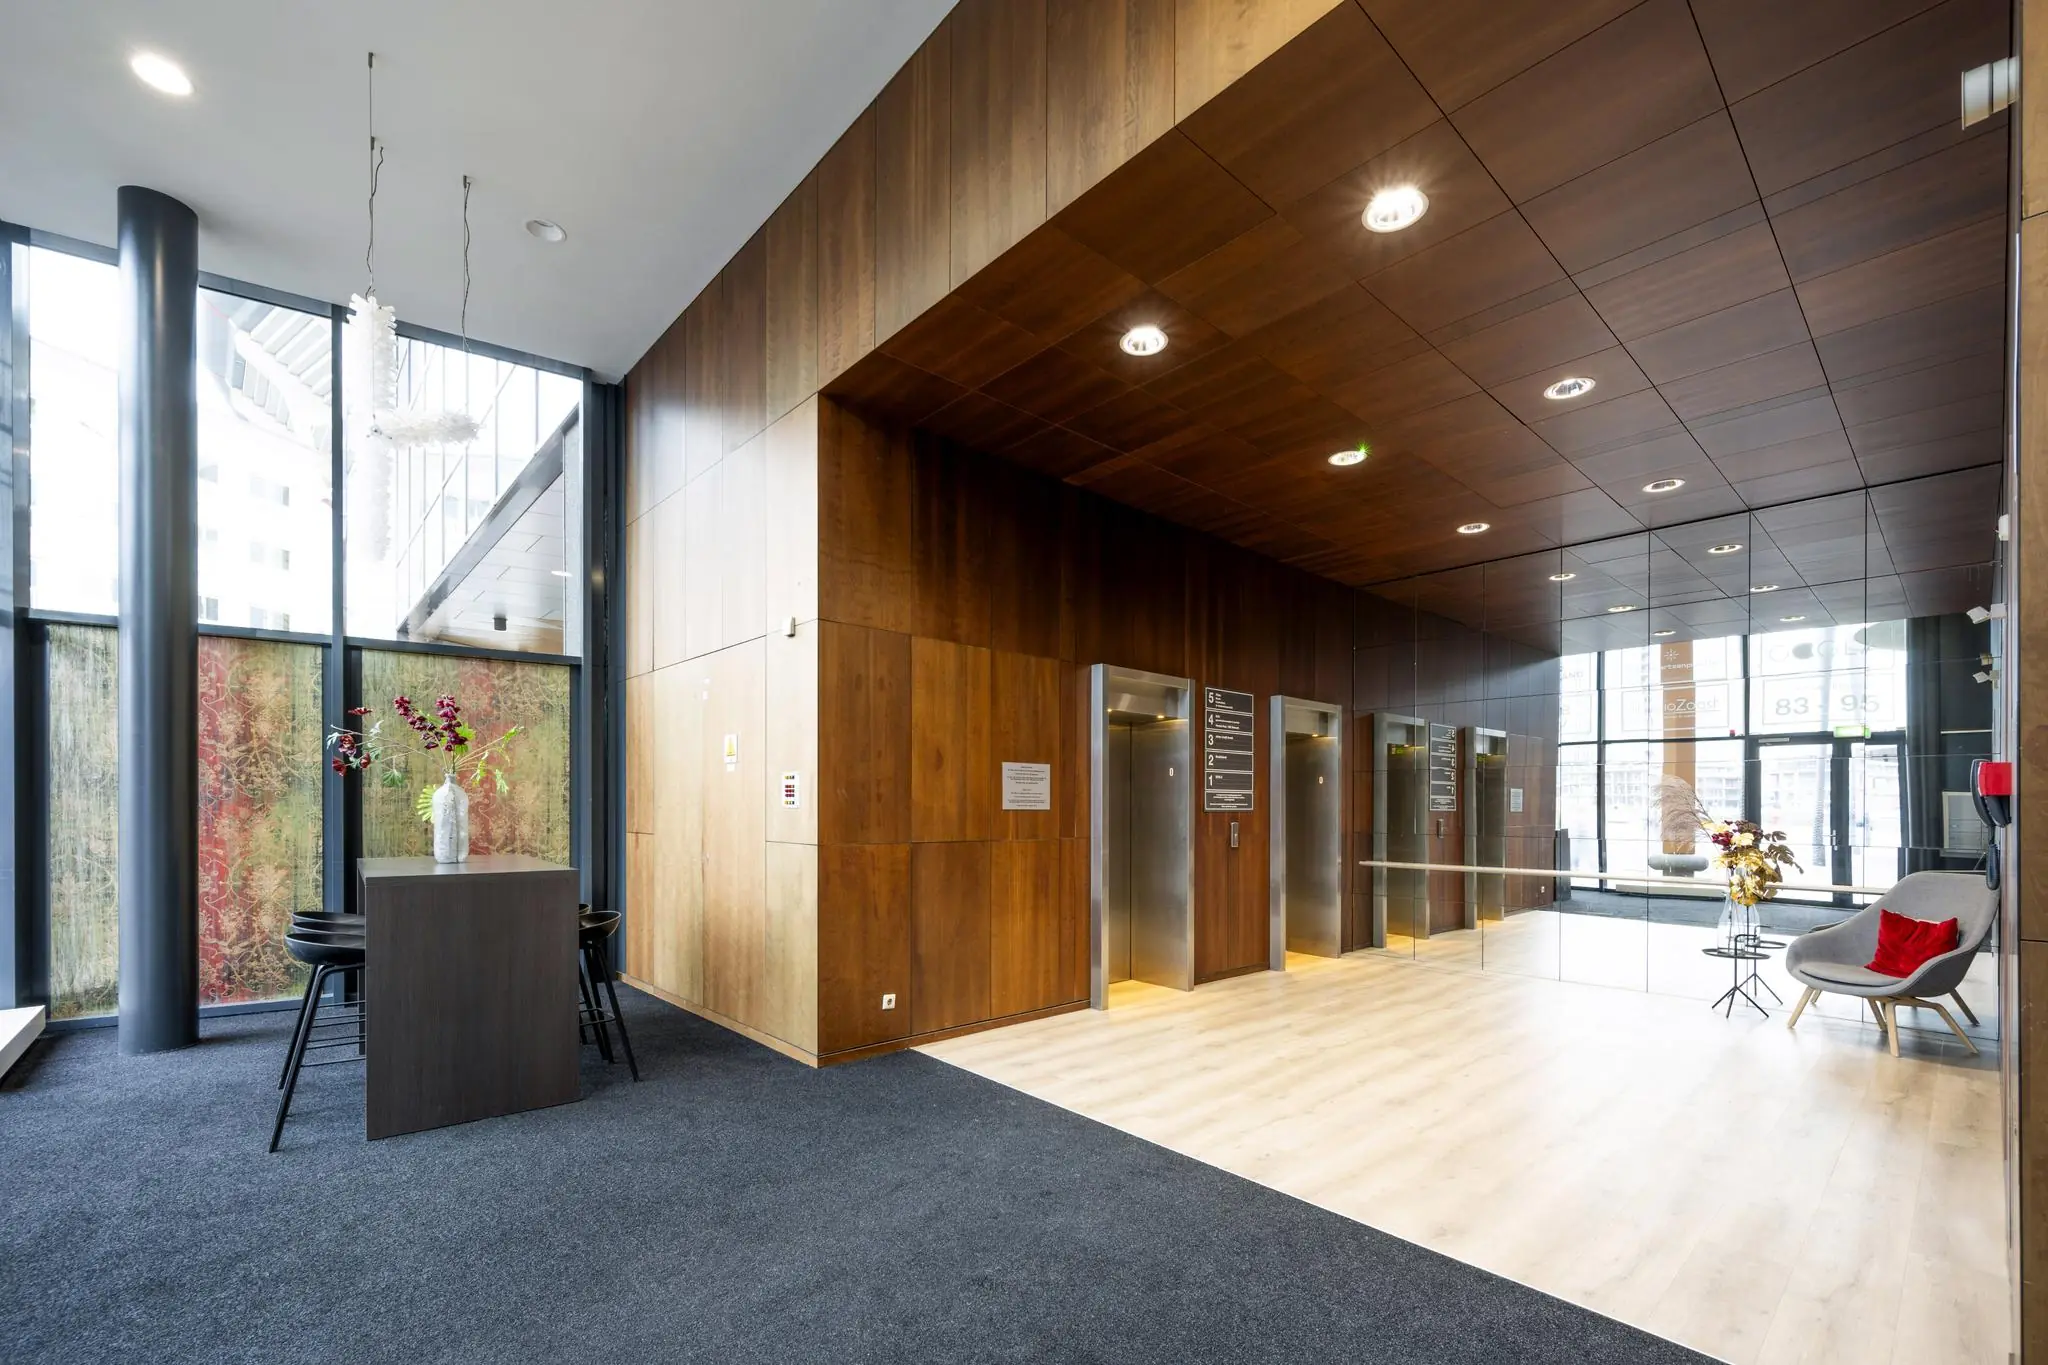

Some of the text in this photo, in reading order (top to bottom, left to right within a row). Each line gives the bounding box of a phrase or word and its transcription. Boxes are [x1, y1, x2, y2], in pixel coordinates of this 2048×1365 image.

[1208, 692, 1214, 704] 5
[1775, 696, 1810, 716] 83
[1840, 693, 1880, 713] 95
[1208, 714, 1214, 725] 4
[1208, 734, 1214, 745] 3
[1208, 754, 1214, 766] 2
[1208, 774, 1213, 786] 1
